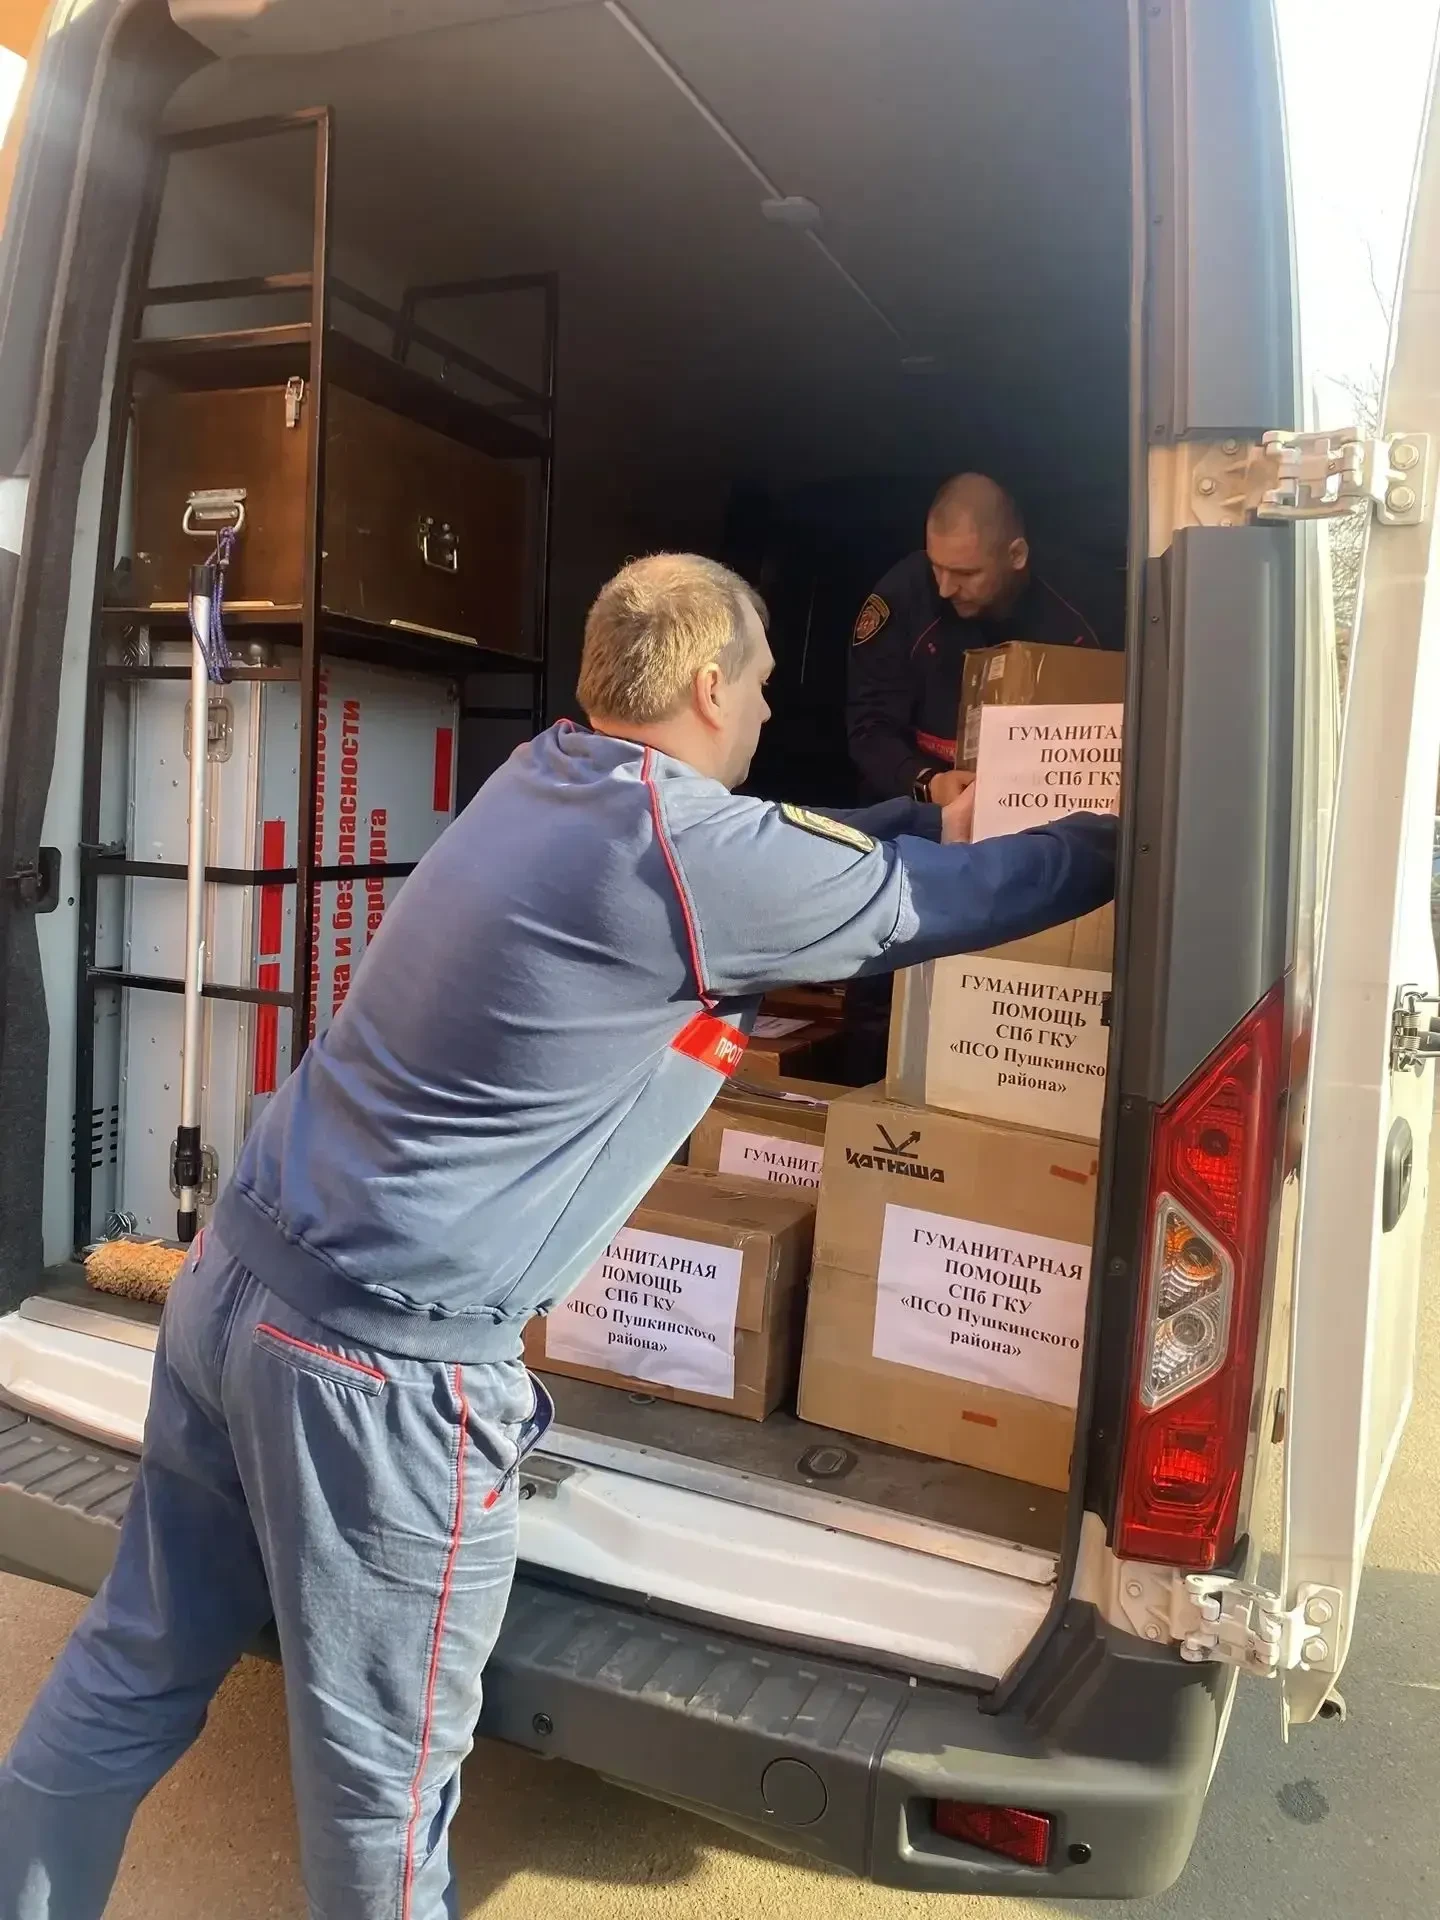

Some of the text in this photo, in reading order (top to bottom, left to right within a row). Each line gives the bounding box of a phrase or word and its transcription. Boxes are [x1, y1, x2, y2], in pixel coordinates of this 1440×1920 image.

[1008, 725, 1122, 741] ГУМАНИТА
[1044, 771, 1083, 786] СПб
[998, 793, 1049, 808] «ПСО
[335, 936, 352, 957] и
[960, 974, 1103, 1006] ГУМАНИТАРН
[991, 1000, 1087, 1028] ПОМОЩЬ
[996, 1023, 1078, 1049] СПб ГКУ
[950, 1040, 1106, 1077] «ПСО Пушкинско
[997, 1072, 1067, 1093] района»
[913, 1228, 1083, 1280] ГУМАНИТАРНАЯ
[601, 1264, 682, 1294] ПОМОЩЬ
[945, 1259, 1042, 1295] ПОМОЩЬ
[604, 1287, 676, 1311] СПб ГКУ
[948, 1283, 1033, 1315] СПб ГКУ
[566, 1300, 716, 1342] «ПСО Пушкинского
[901, 1295, 1080, 1350] «ПСО Пушкинского
[607, 1330, 668, 1352] района»
[950, 1329, 1022, 1357] района»
